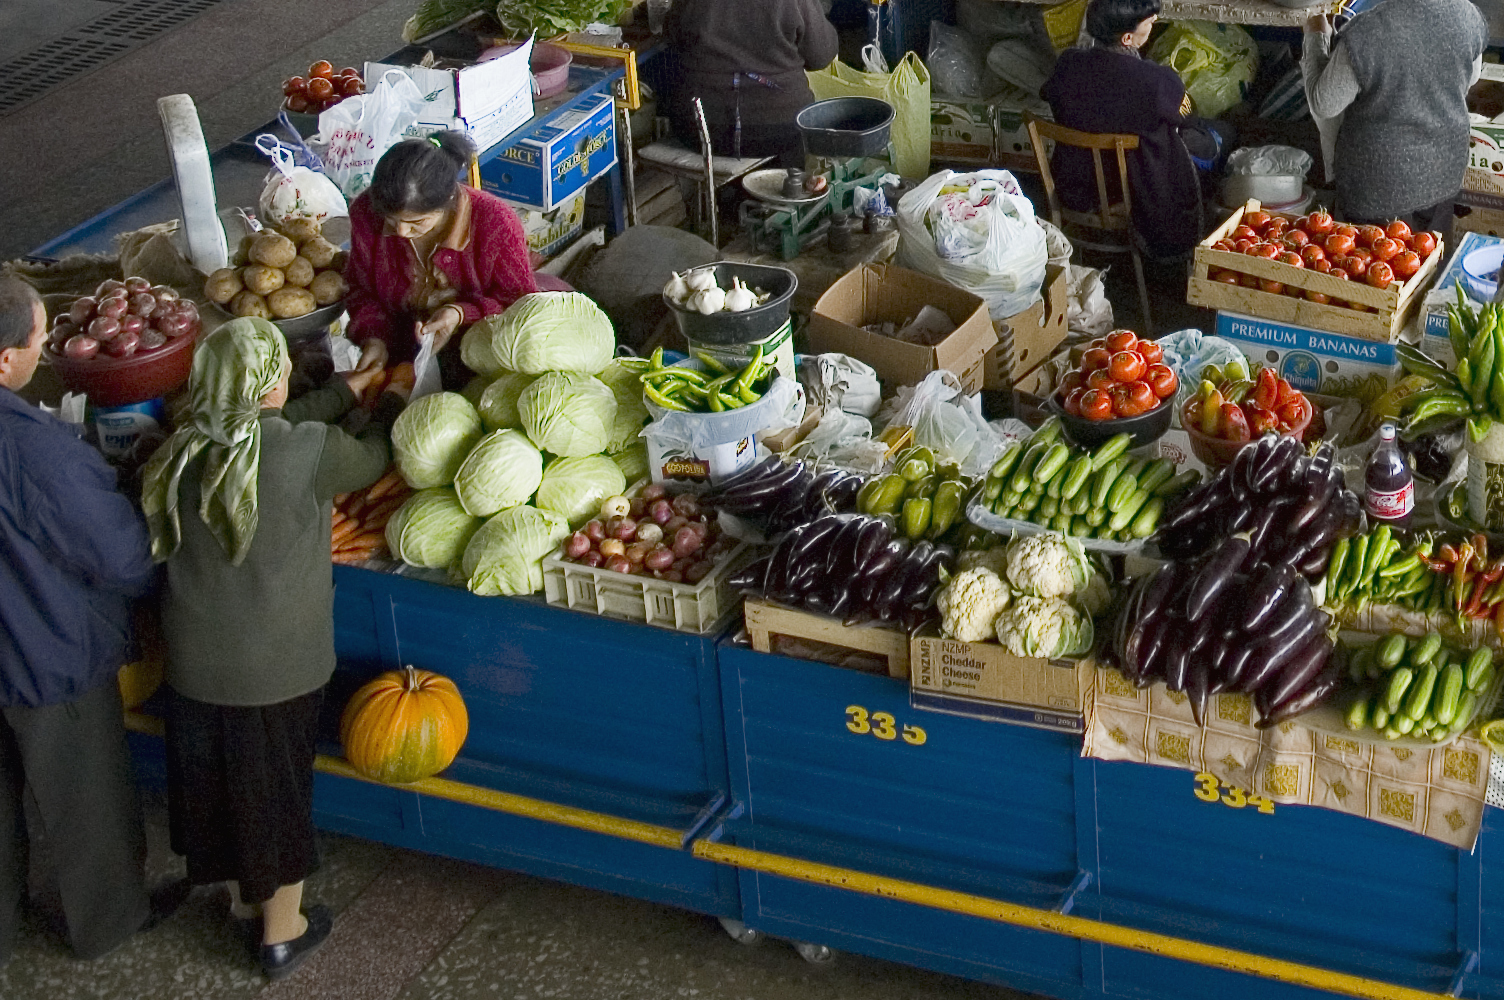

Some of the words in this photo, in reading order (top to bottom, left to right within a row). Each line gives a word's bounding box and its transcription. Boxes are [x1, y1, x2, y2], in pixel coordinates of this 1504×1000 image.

[1462, 193, 1504, 207] BANANAS
[1231, 322, 1299, 345] PREMIUM
[1308, 335, 1378, 358] BANANAS
[920, 640, 931, 671] NZMP
[942, 641, 971, 656] NZMP
[942, 654, 987, 671] Cheddar
[942, 667, 981, 682] Cheese
[846, 704, 928, 746] 335
[1194, 772, 1275, 815] 334
